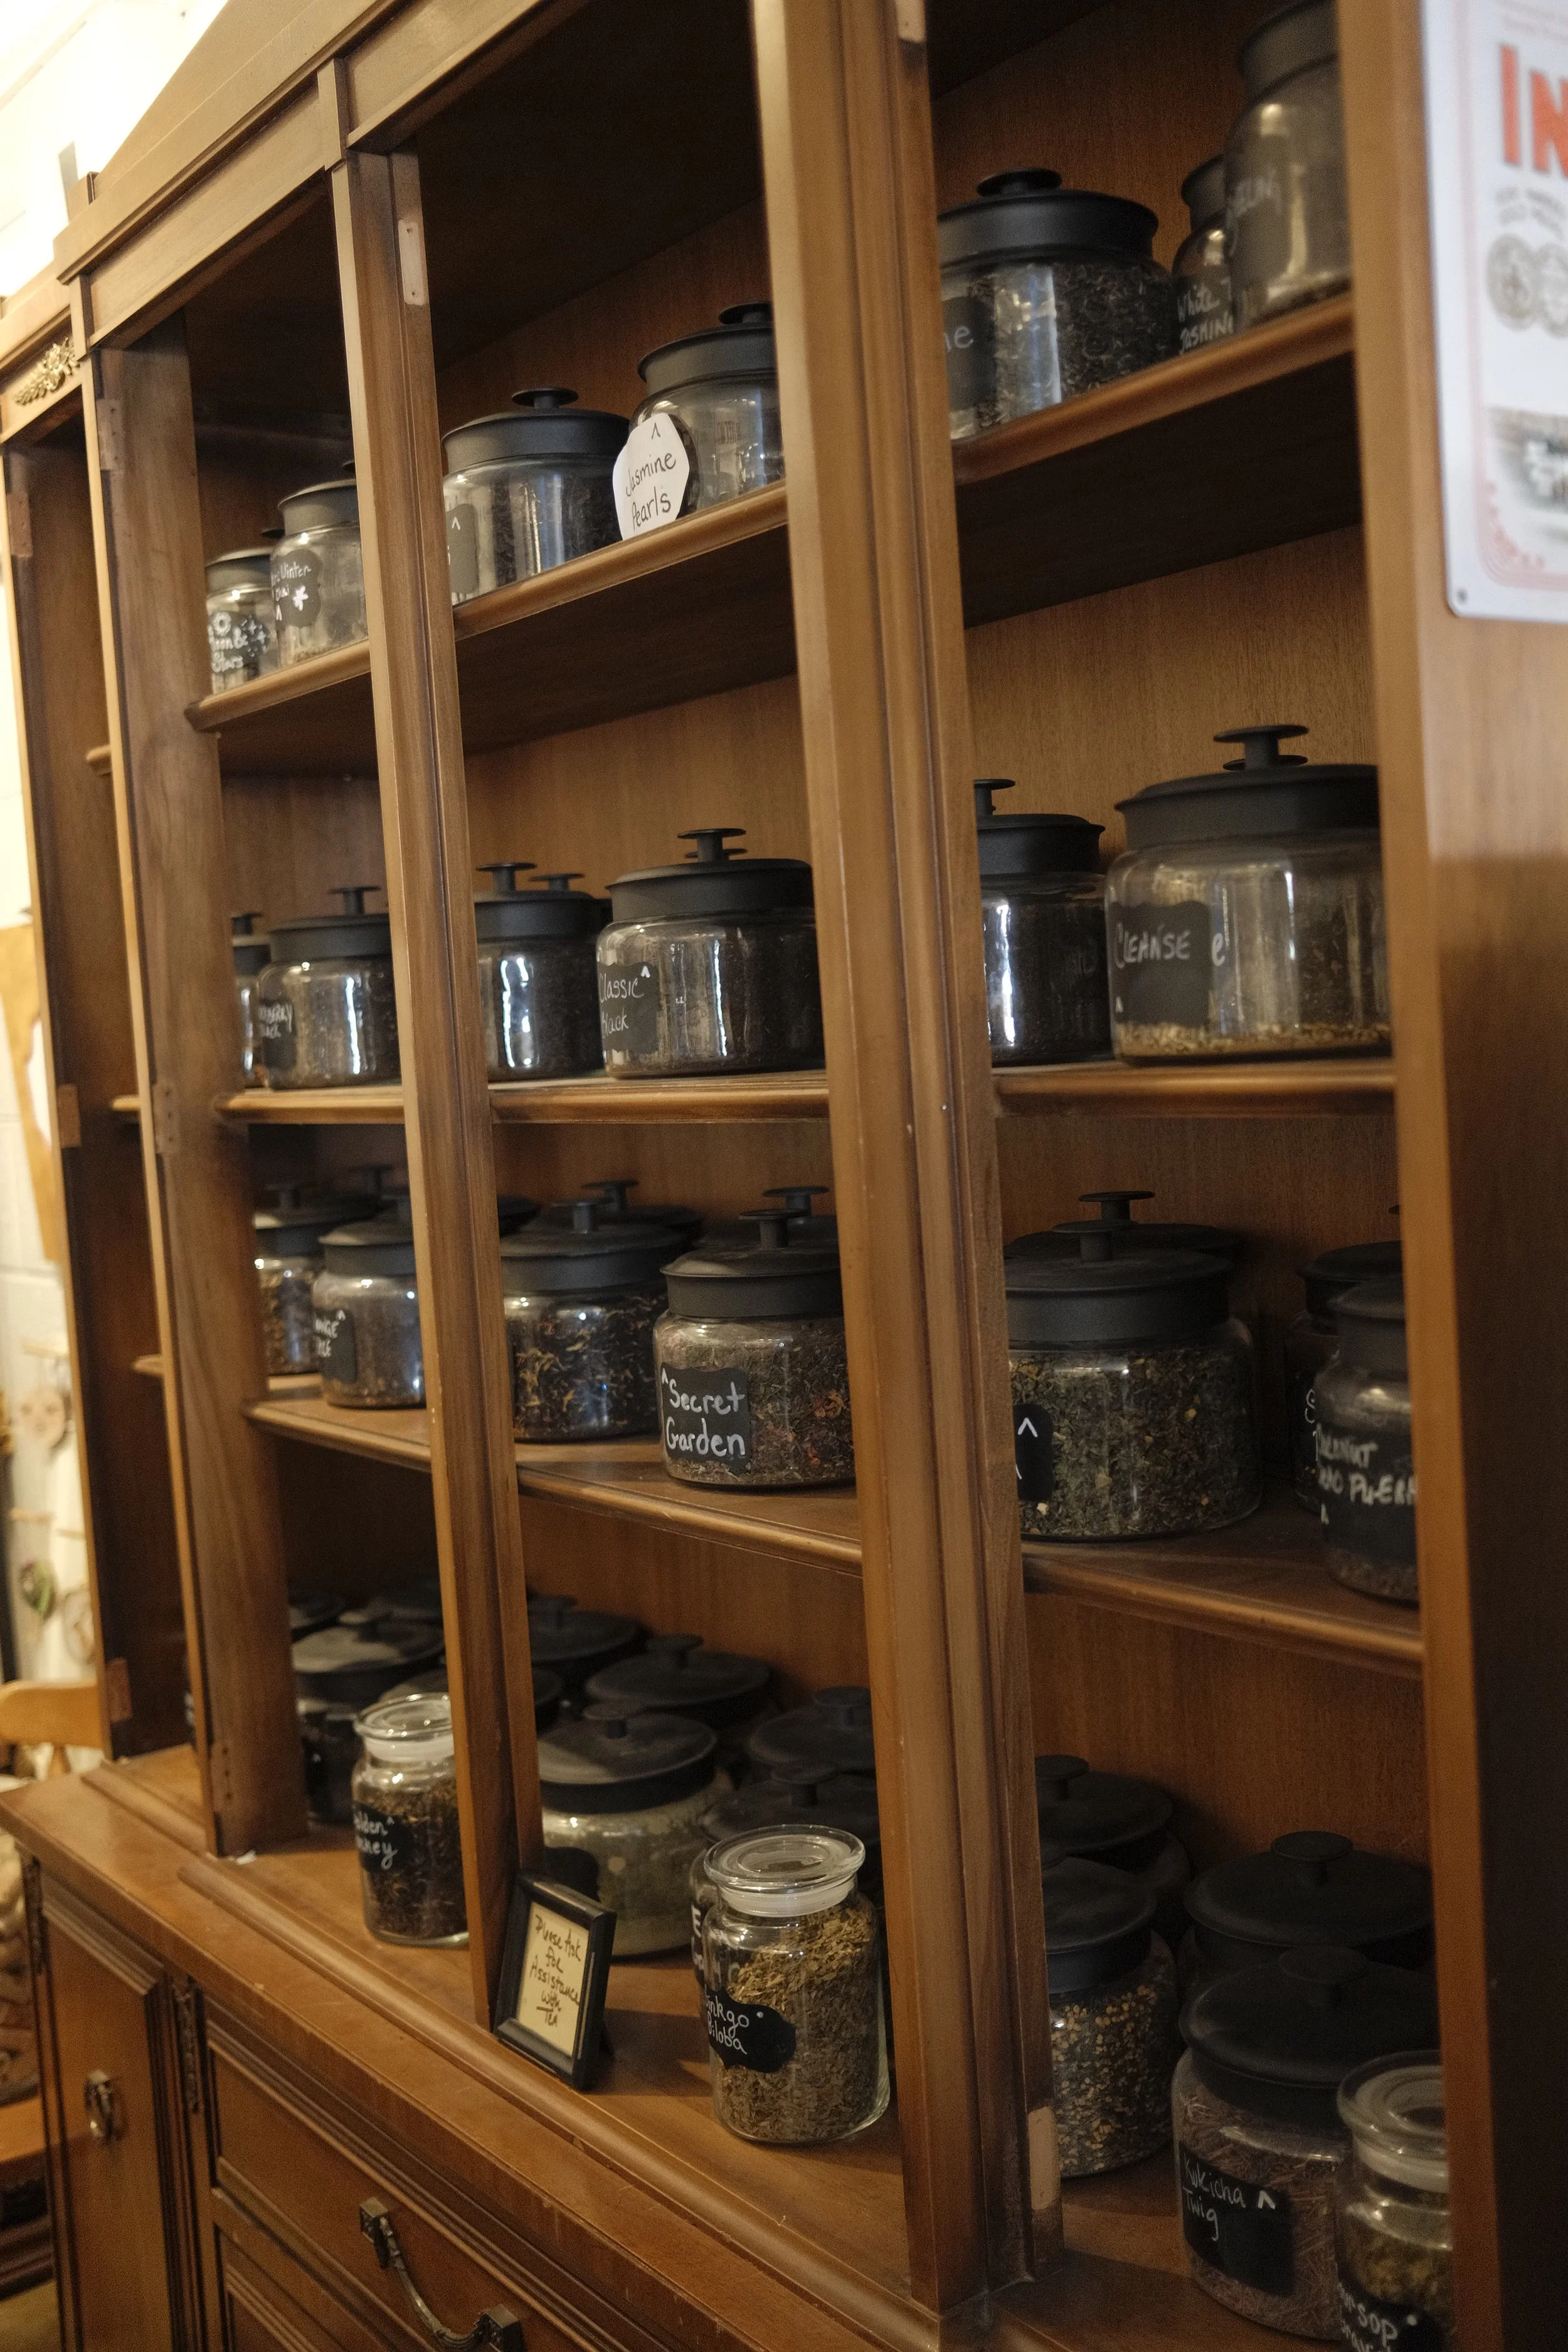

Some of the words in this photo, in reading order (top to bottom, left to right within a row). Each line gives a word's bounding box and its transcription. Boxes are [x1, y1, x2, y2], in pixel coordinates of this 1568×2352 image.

[626, 453, 676, 497] Jasmine
[632, 486, 671, 531] Pearls
[599, 973, 645, 1004] Classic
[669, 1379, 745, 1415] Secret
[666, 1416, 746, 1456] Garden
[707, 2010, 748, 2055] Biloba
[1184, 2153, 1247, 2208] Kukicha
[1182, 2185, 1219, 2242] Twig
